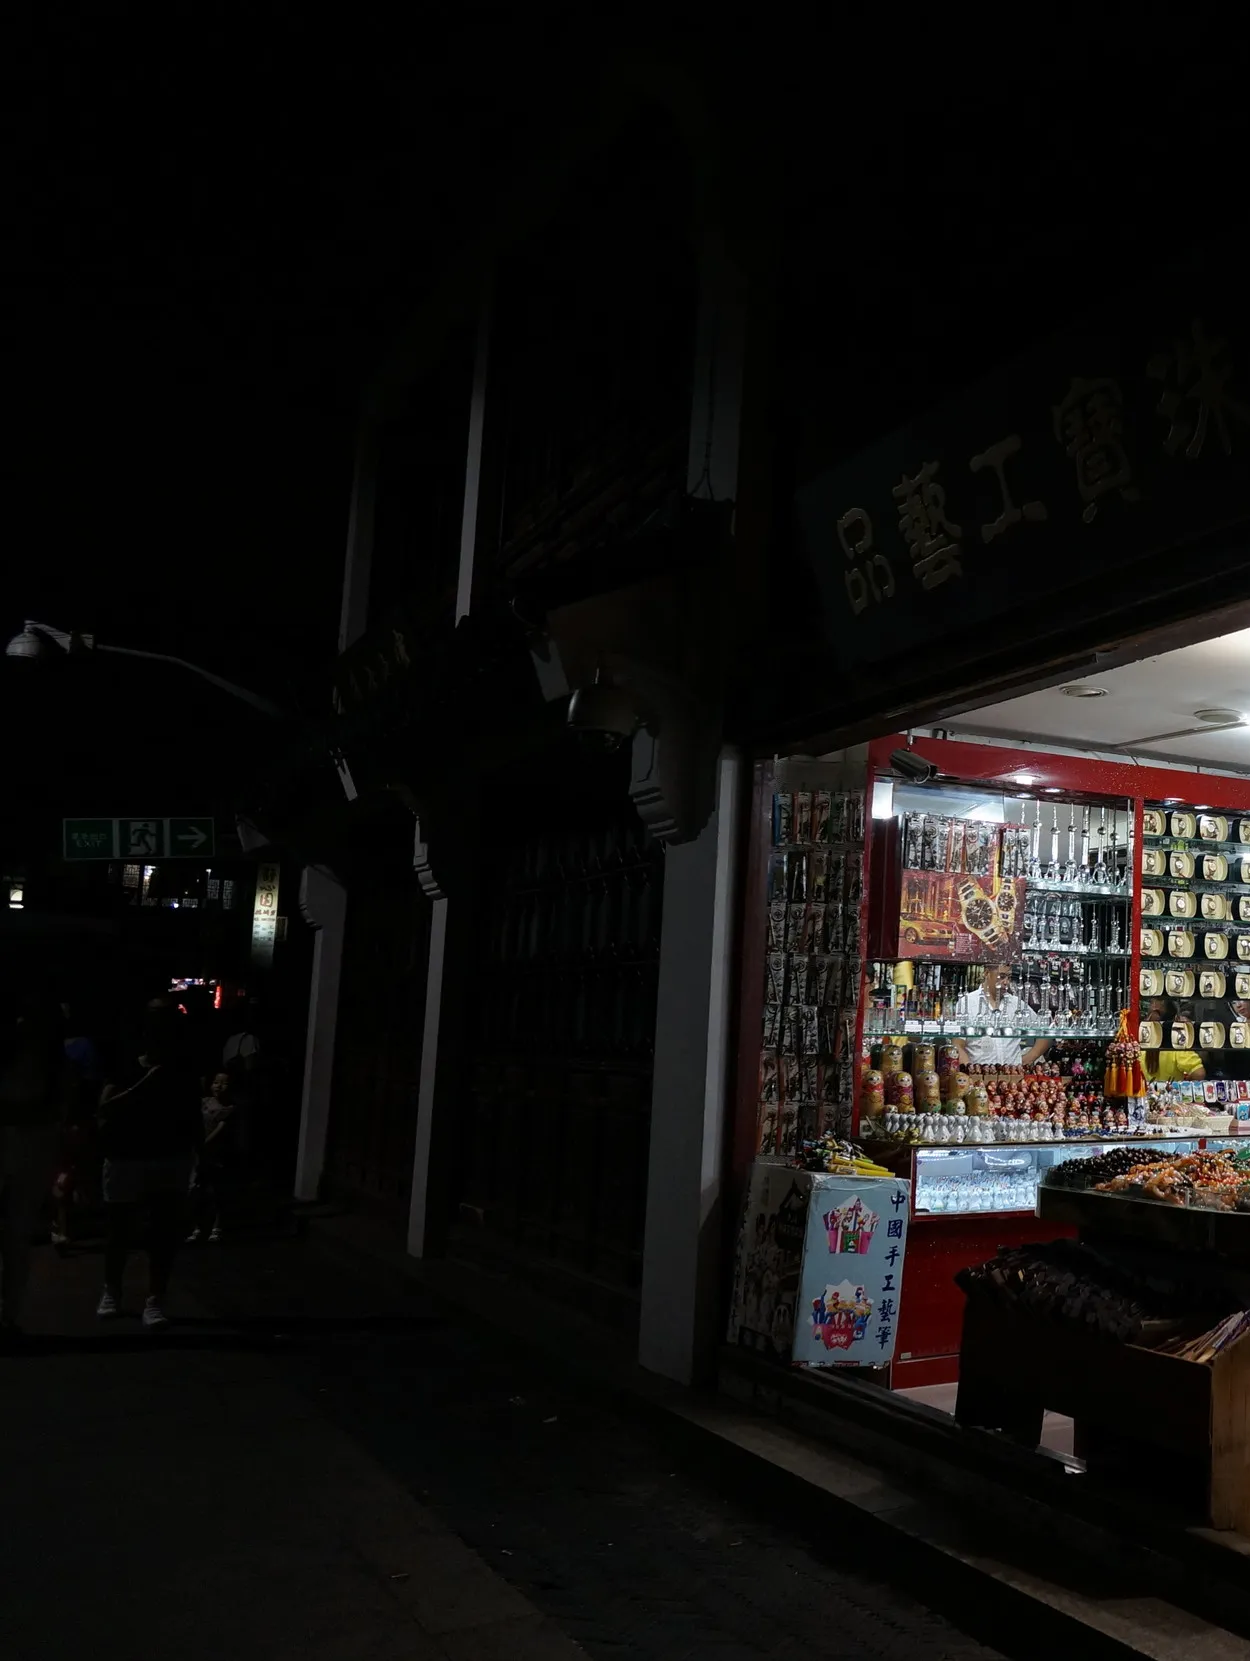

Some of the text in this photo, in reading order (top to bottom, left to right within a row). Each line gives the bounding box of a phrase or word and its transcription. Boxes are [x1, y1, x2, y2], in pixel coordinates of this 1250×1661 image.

[875, 1191, 905, 1349] 中國手工藝筆
